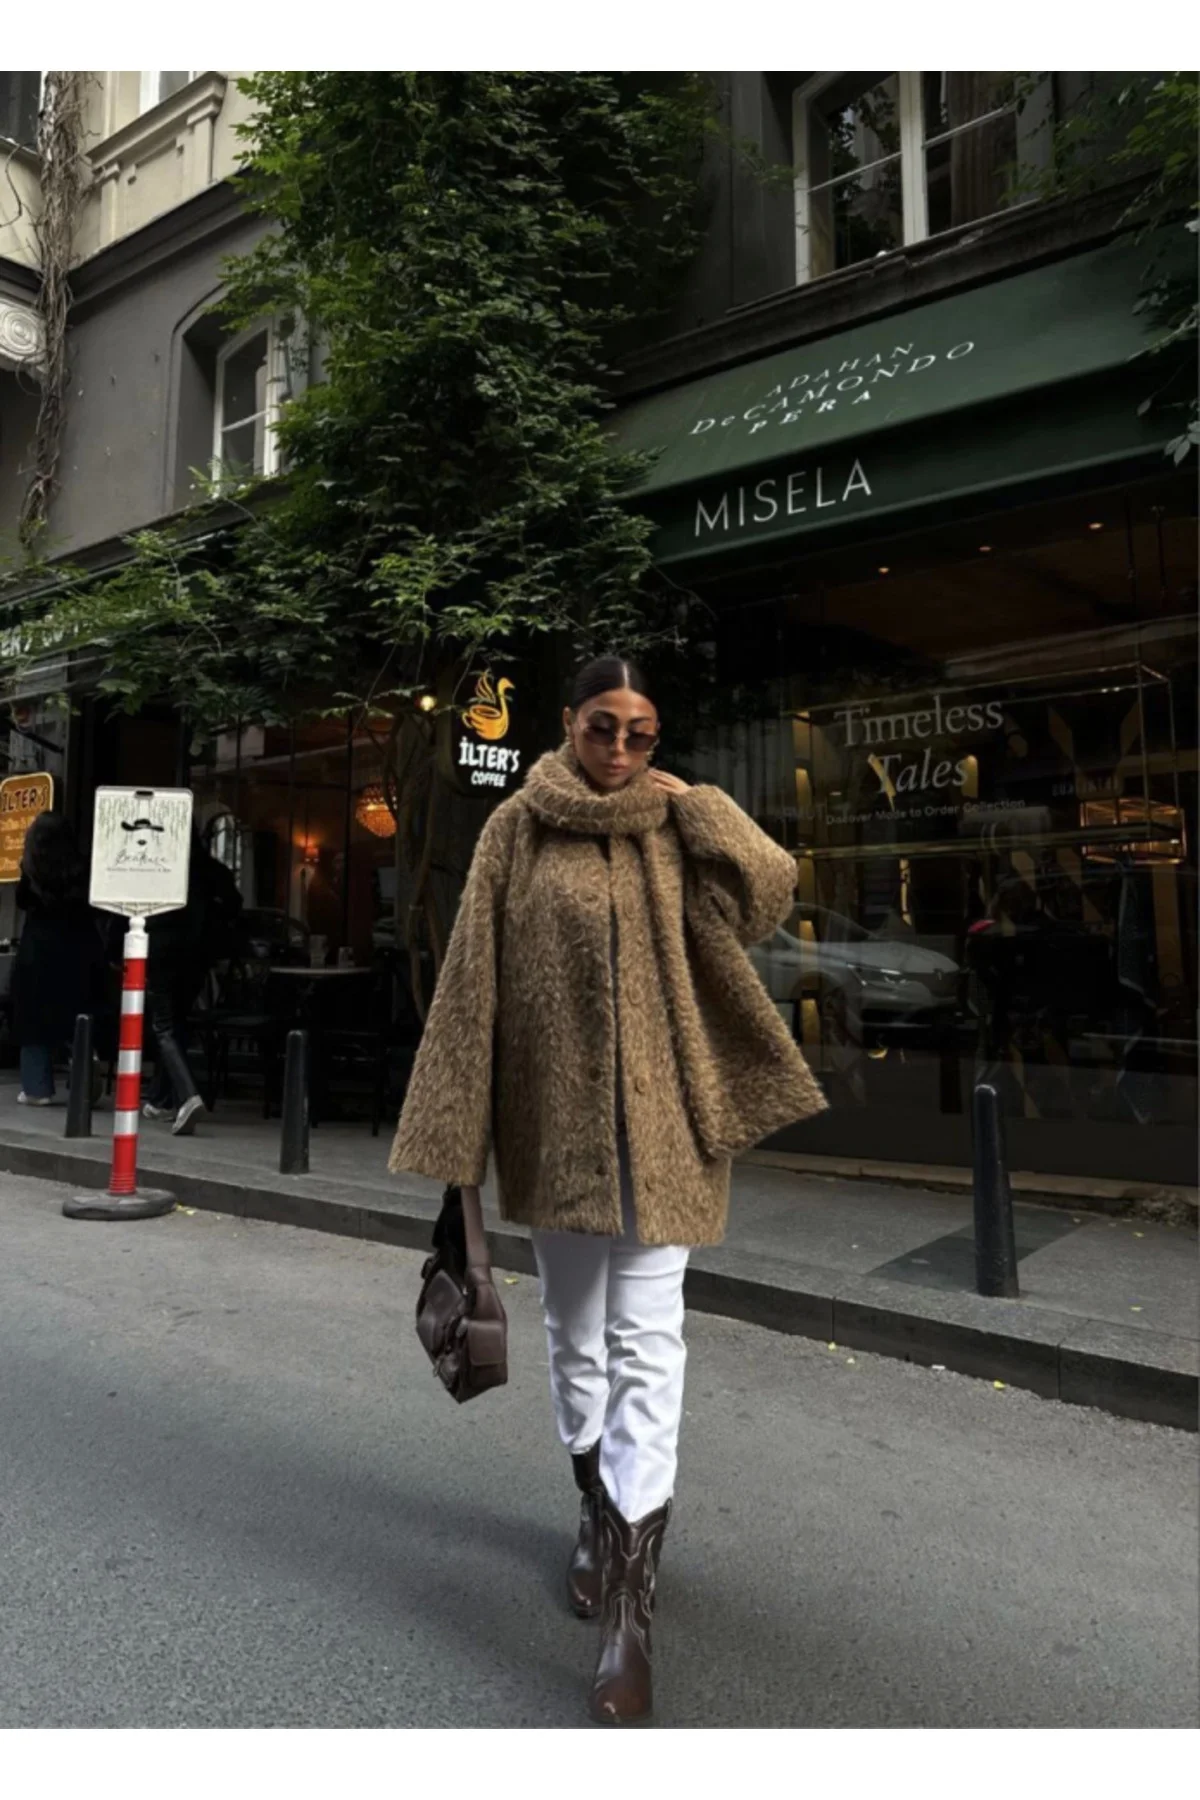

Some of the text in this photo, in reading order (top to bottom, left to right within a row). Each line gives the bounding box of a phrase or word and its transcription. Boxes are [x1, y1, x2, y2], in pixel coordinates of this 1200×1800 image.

[688, 341, 975, 436] DeCAMONDO
[766, 343, 914, 397] ADAHAN
[748, 390, 871, 434] PERA
[694, 457, 872, 537] MISELA
[833, 694, 1005, 747] Timeless
[470, 769, 507, 788] COFFEE
[874, 746, 969, 795] Tales
[825, 812, 872, 826] Discover
[874, 809, 905, 822] Made
[908, 806, 923, 818] to
[924, 802, 960, 816] Order
[962, 798, 1026, 814] Collection
